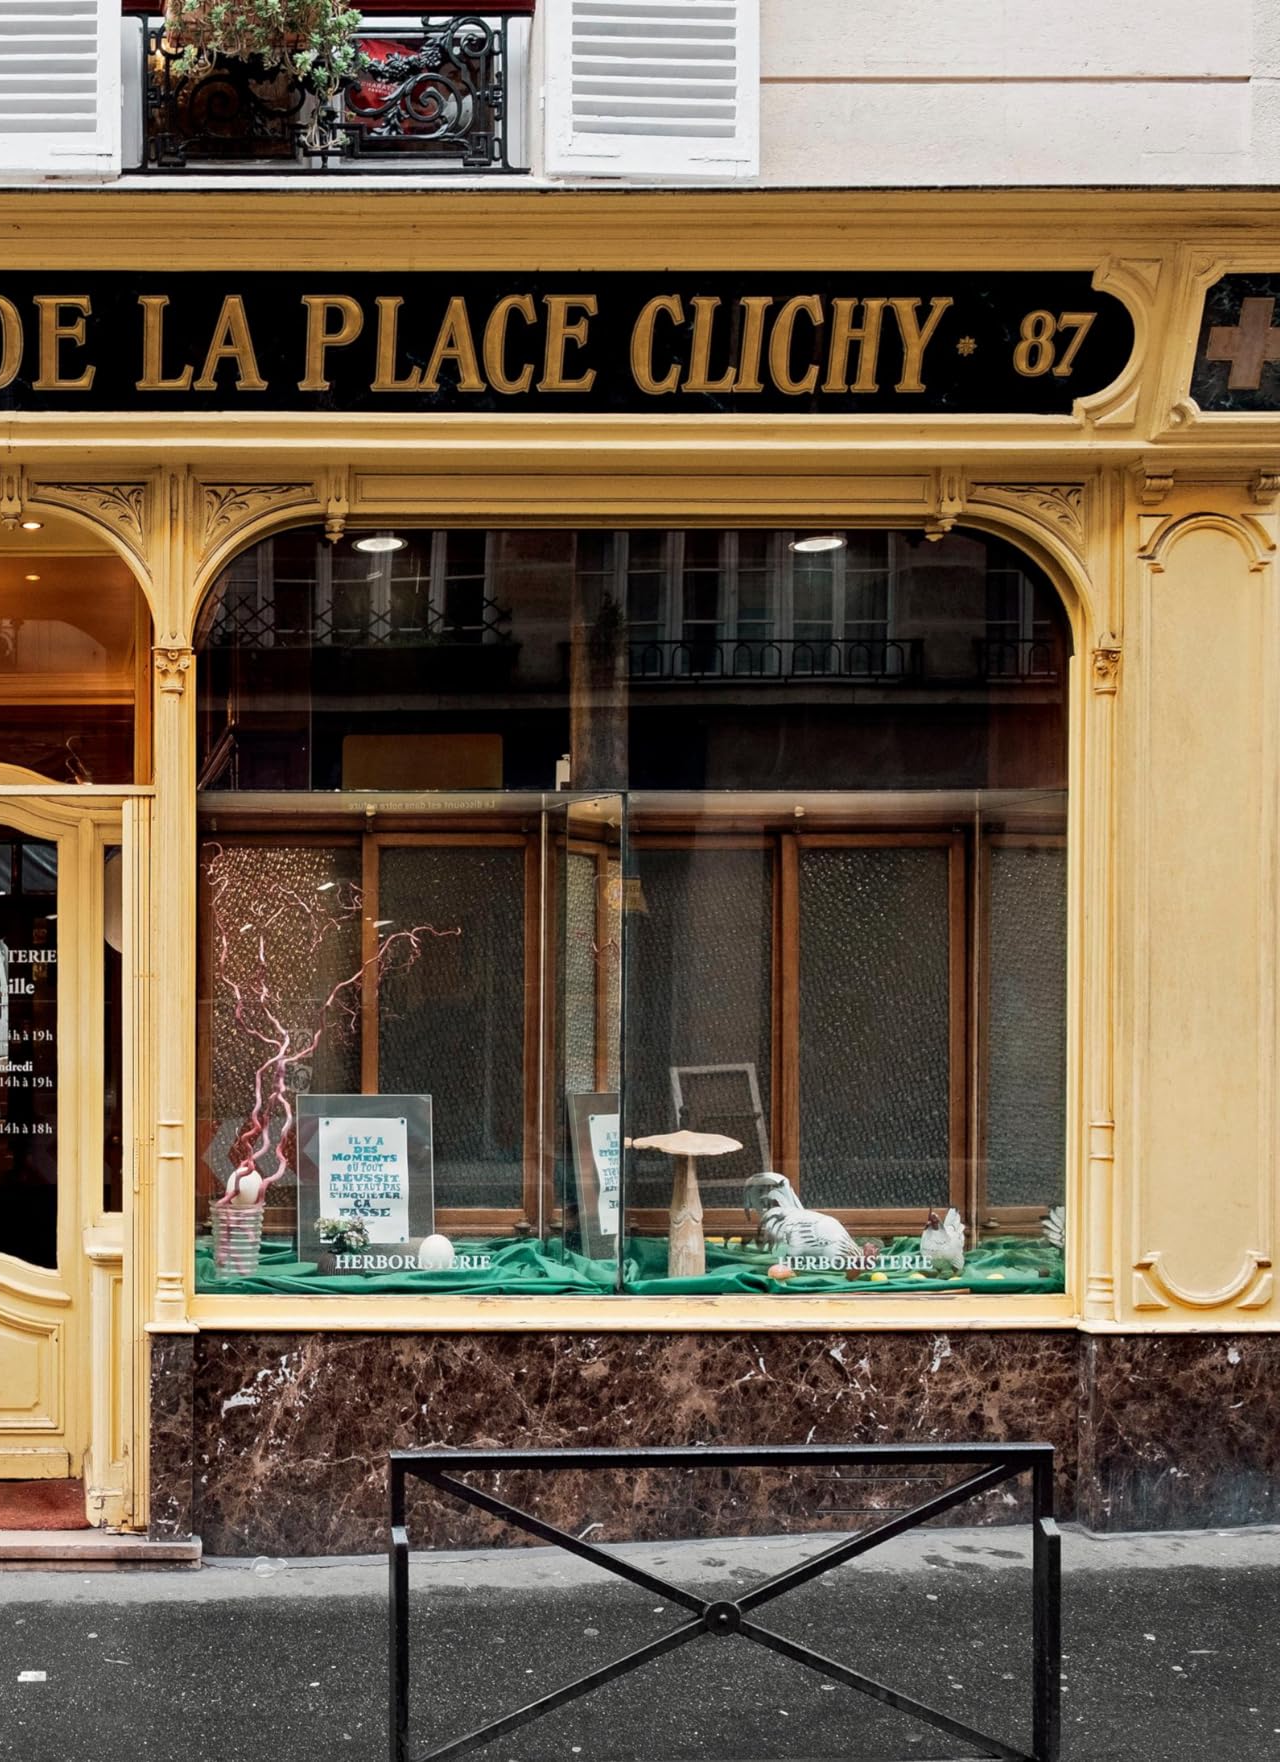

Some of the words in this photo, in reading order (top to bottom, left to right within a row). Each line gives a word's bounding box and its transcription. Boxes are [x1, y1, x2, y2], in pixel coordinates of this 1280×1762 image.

[136, 293, 269, 393] LA
[298, 293, 599, 395] PLACE
[629, 294, 954, 395] CLICHY
[1012, 309, 1098, 378] 87
[23, 1030, 29, 1041] à
[22, 1076, 28, 1087] à
[22, 1122, 28, 1134] à
[364, 1136, 372, 1145] Y
[376, 1136, 384, 1145] A
[353, 1146, 378, 1154] DES
[331, 1153, 398, 1162] MOMENTS
[361, 1162, 384, 1172] TOUT
[329, 1183, 339, 1192] IL
[342, 1183, 354, 1192] NE
[383, 1183, 401, 1192] PAS
[339, 1207, 391, 1217] PASSE
[335, 1254, 492, 1270] HERBORIERIE
[779, 1254, 934, 1270] HERBORISTERIE
